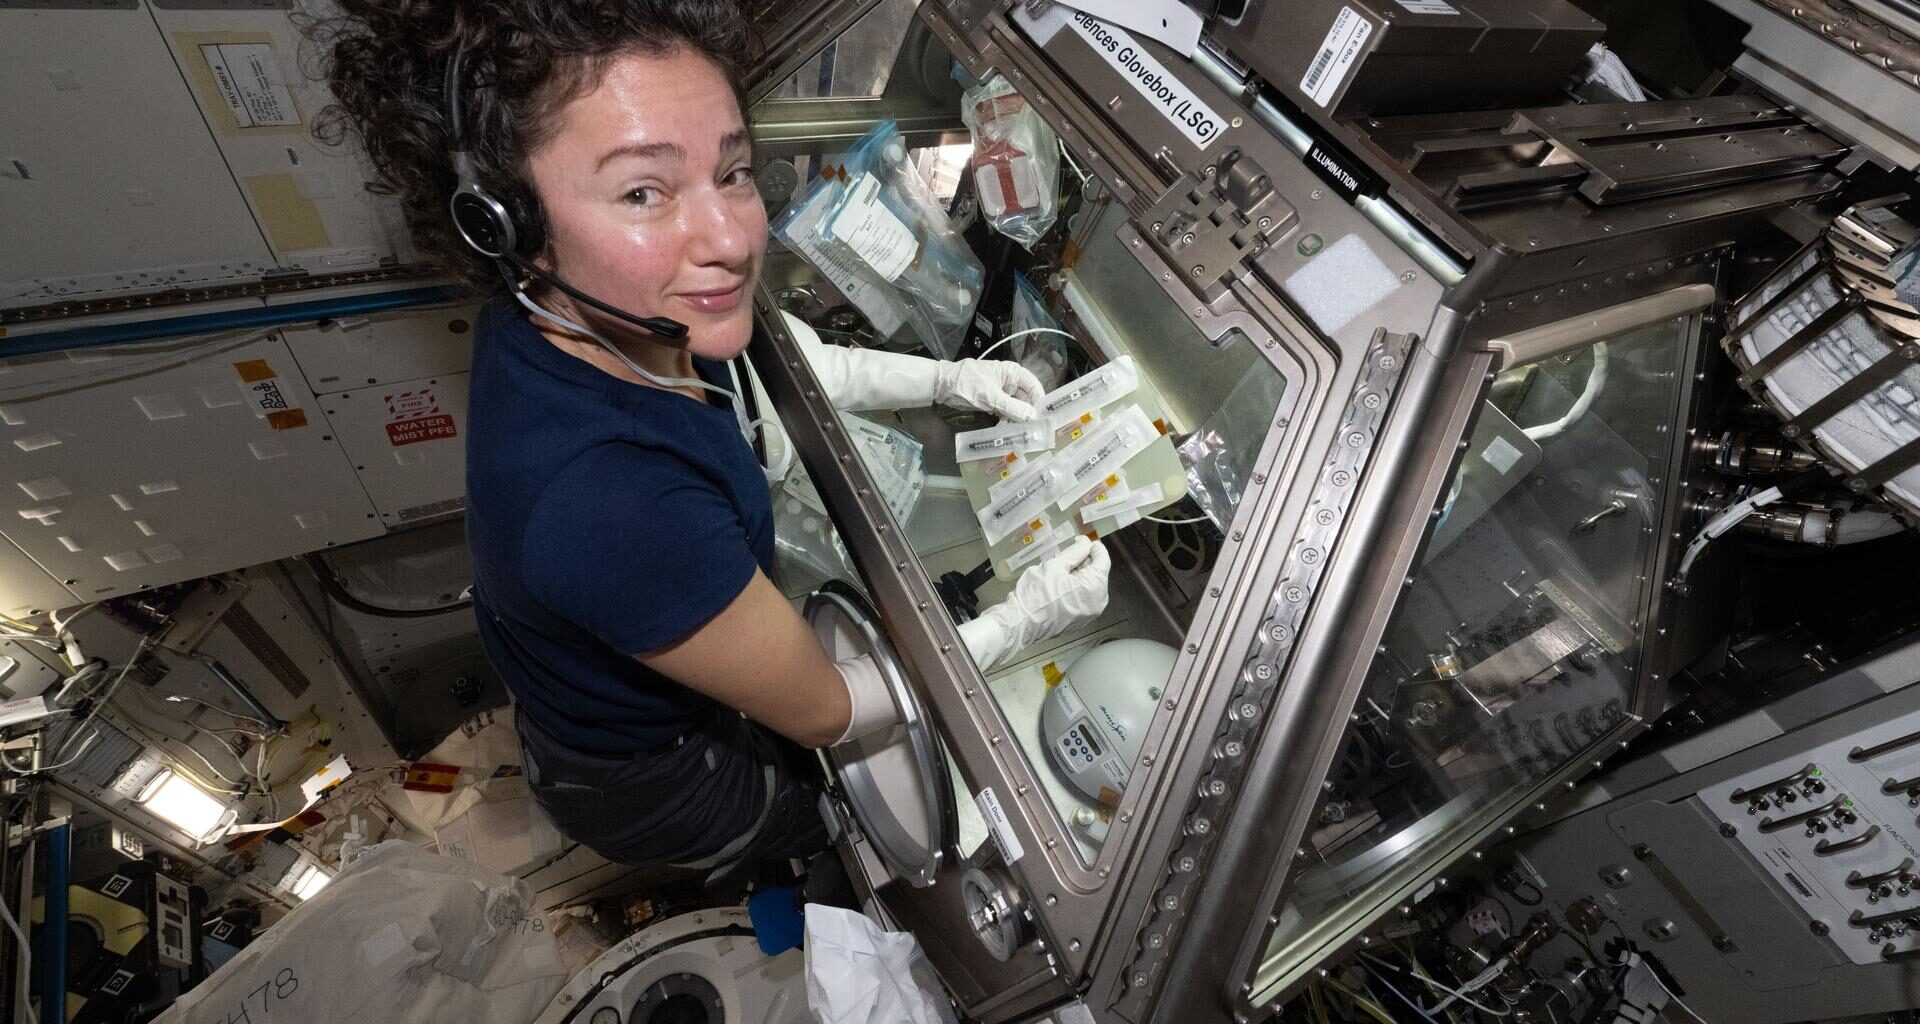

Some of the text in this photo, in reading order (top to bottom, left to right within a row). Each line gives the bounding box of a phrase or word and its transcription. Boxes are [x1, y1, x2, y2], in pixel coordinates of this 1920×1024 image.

[1341, 23, 1369, 63] Fan E-Box
[1117, 44, 1177, 106] Glovebox
[1171, 99, 1219, 145] (LSG)
[1312, 148, 1358, 191] ILLUMINATION
[401, 400, 423, 409] FIRE
[392, 425, 456, 442] MIST PFE
[395, 417, 446, 431] WATER
[982, 789, 994, 806] Main
[991, 805, 1003, 823] Door
[1882, 822, 1920, 859] FUNCTIONS
